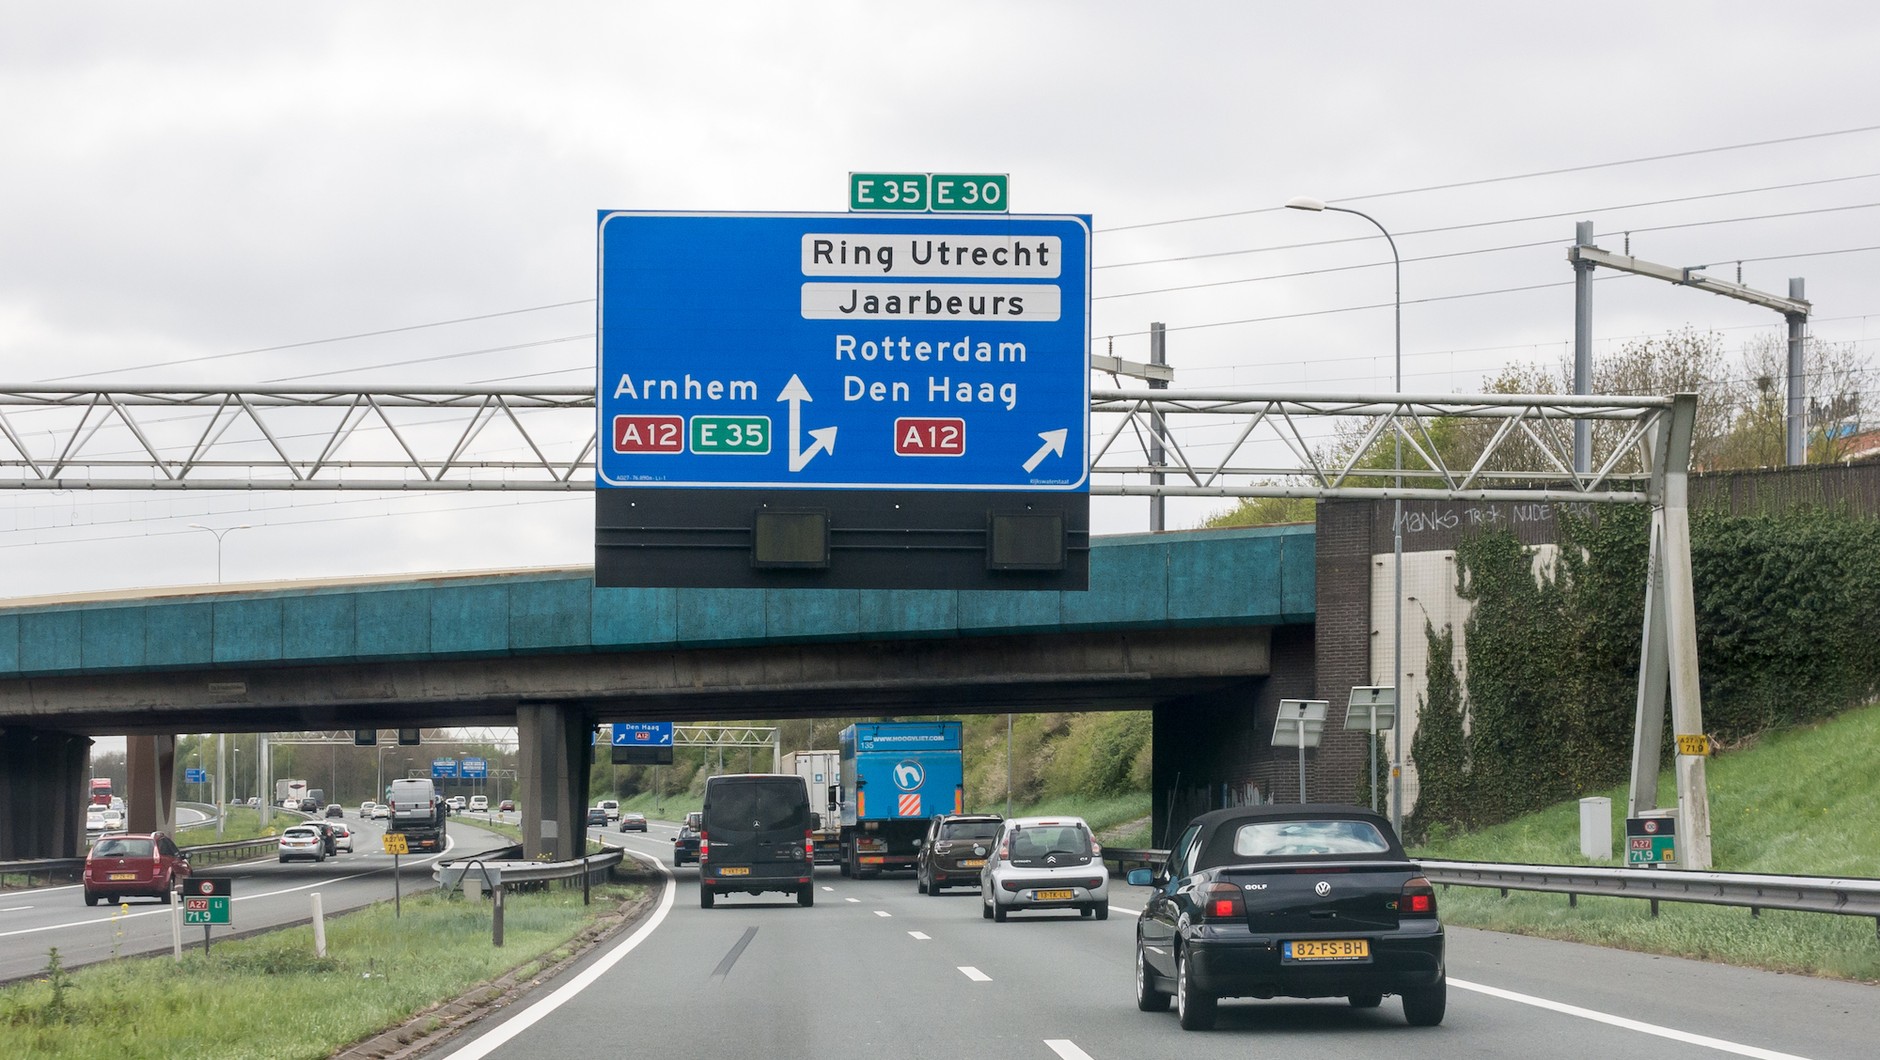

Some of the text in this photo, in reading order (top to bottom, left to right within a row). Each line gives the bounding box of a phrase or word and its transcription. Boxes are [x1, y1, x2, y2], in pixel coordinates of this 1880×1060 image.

[858, 181, 920, 203] E 35
[938, 182, 1000, 205] E 30
[813, 240, 1049, 273] Ring Utrecht
[839, 289, 1024, 315] Jaarbeurs
[836, 335, 1026, 362] Rotterdam
[613, 374, 757, 400] Arnhem
[844, 376, 1017, 411] Den Haag
[621, 423, 677, 446] A12
[701, 424, 763, 446] E 35
[902, 426, 958, 448] A12
[1631, 851, 1653, 861] 71,9
[190, 900, 223, 909] A27 Li
[187, 911, 212, 922] 71,9
[1297, 942, 1363, 956] 82-FS-BH
